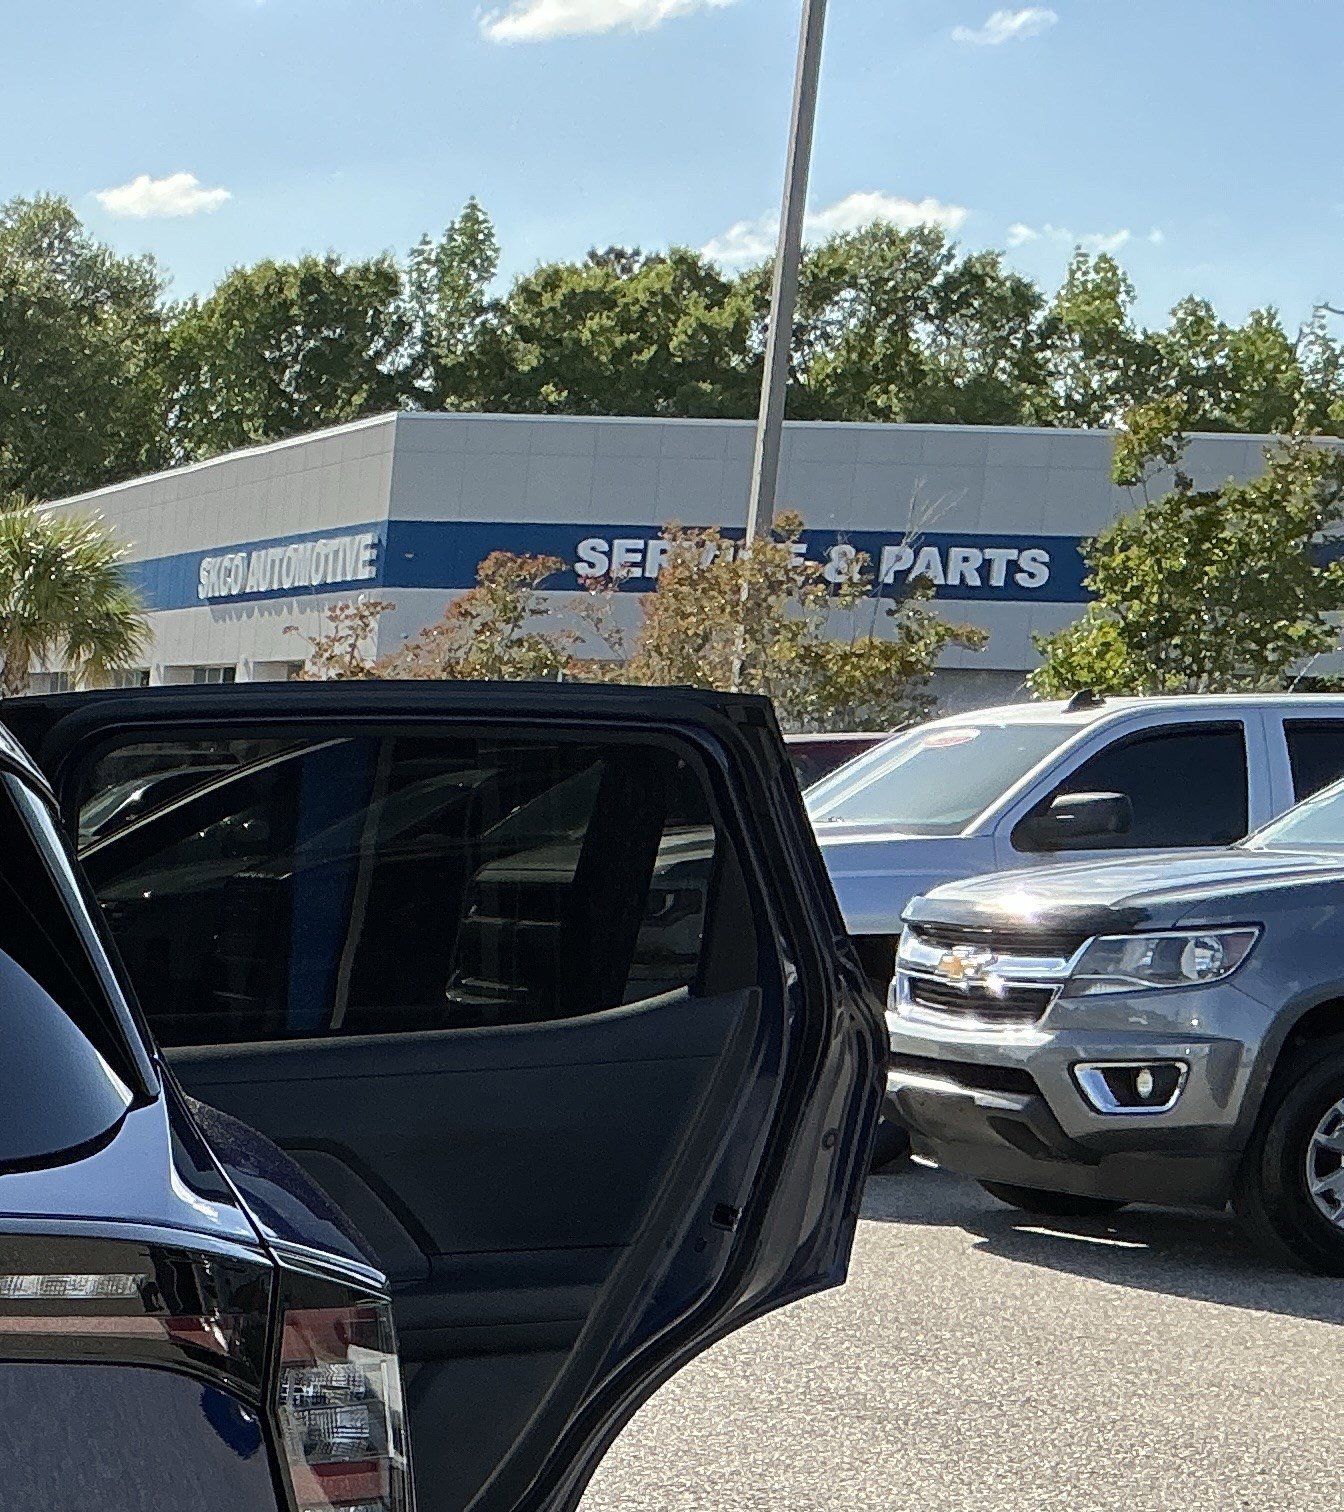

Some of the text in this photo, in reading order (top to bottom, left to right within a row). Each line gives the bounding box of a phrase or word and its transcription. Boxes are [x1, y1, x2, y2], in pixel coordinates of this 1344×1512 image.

[198, 532, 379, 600] SKCO AUTOMOTIVE
[882, 545, 1051, 588] PARTS
